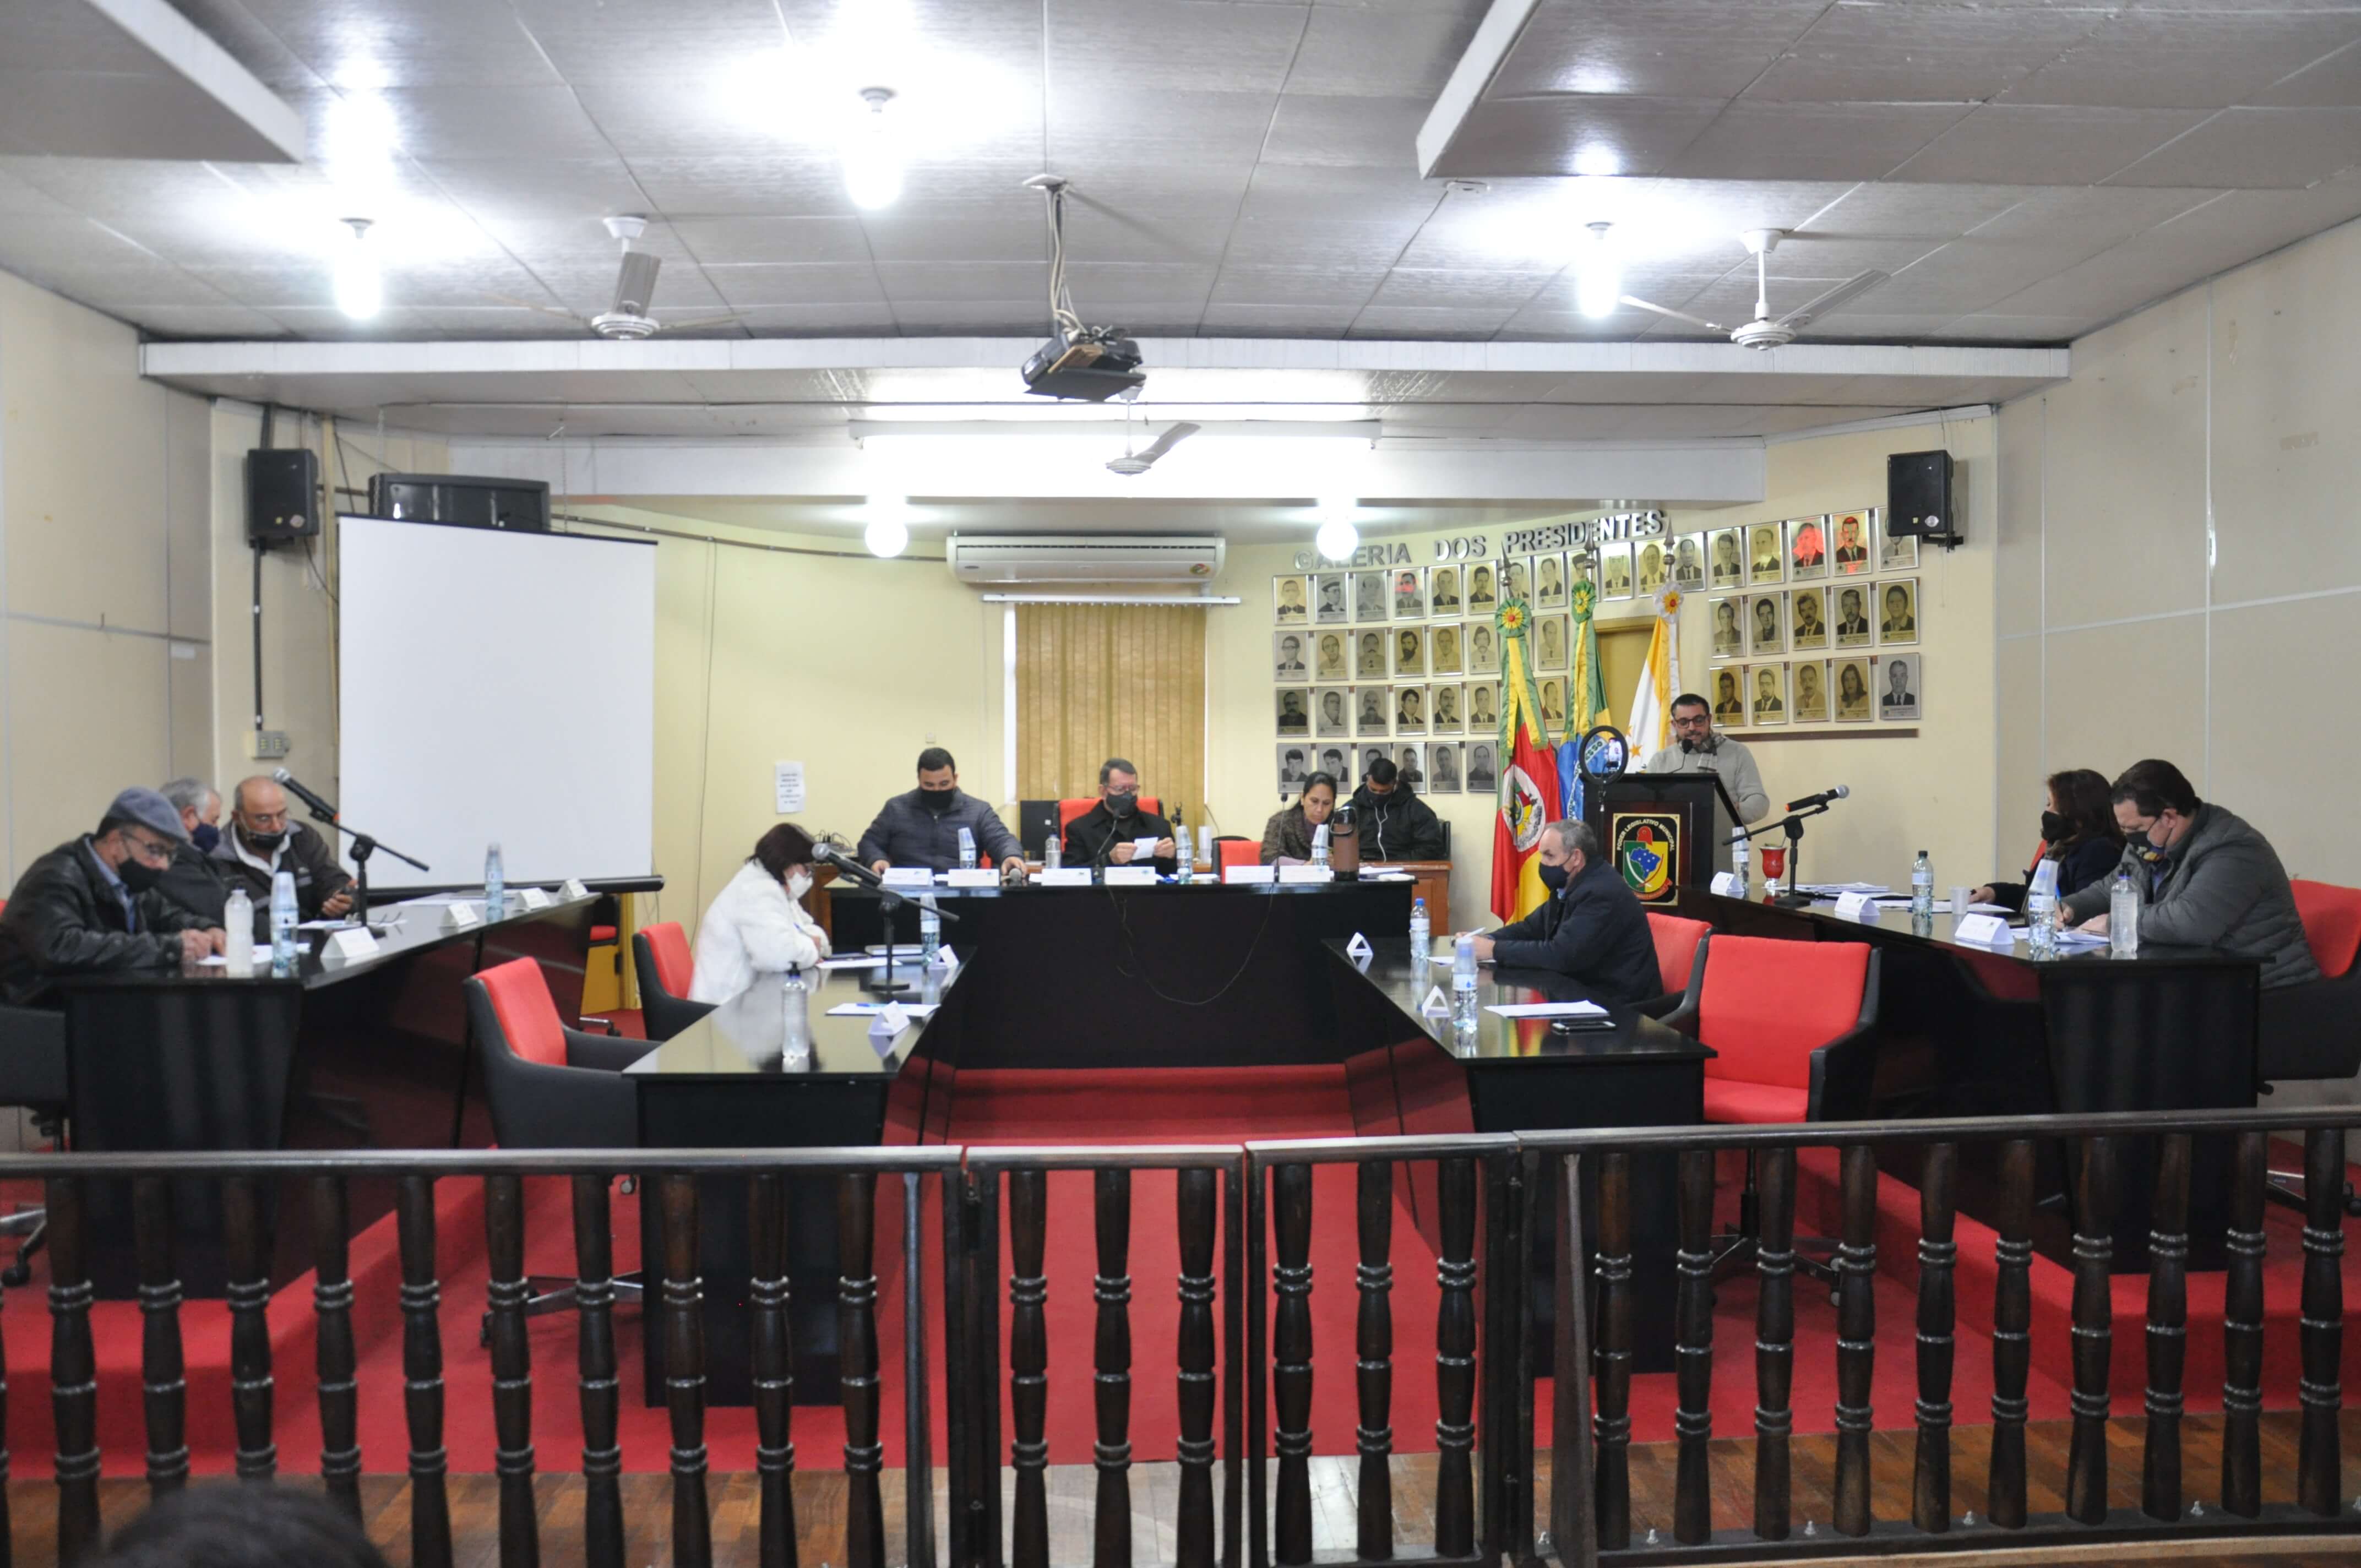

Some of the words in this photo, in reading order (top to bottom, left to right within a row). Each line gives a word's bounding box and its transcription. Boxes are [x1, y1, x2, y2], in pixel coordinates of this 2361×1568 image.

[1434, 535, 1486, 561] DOS
[1504, 510, 1666, 553] PRESIDENTES
[1617, 830, 1626, 851] PODER
[1624, 819, 1660, 832] LEGISLATIVO
[1658, 823, 1675, 852] MUNICIPAL
